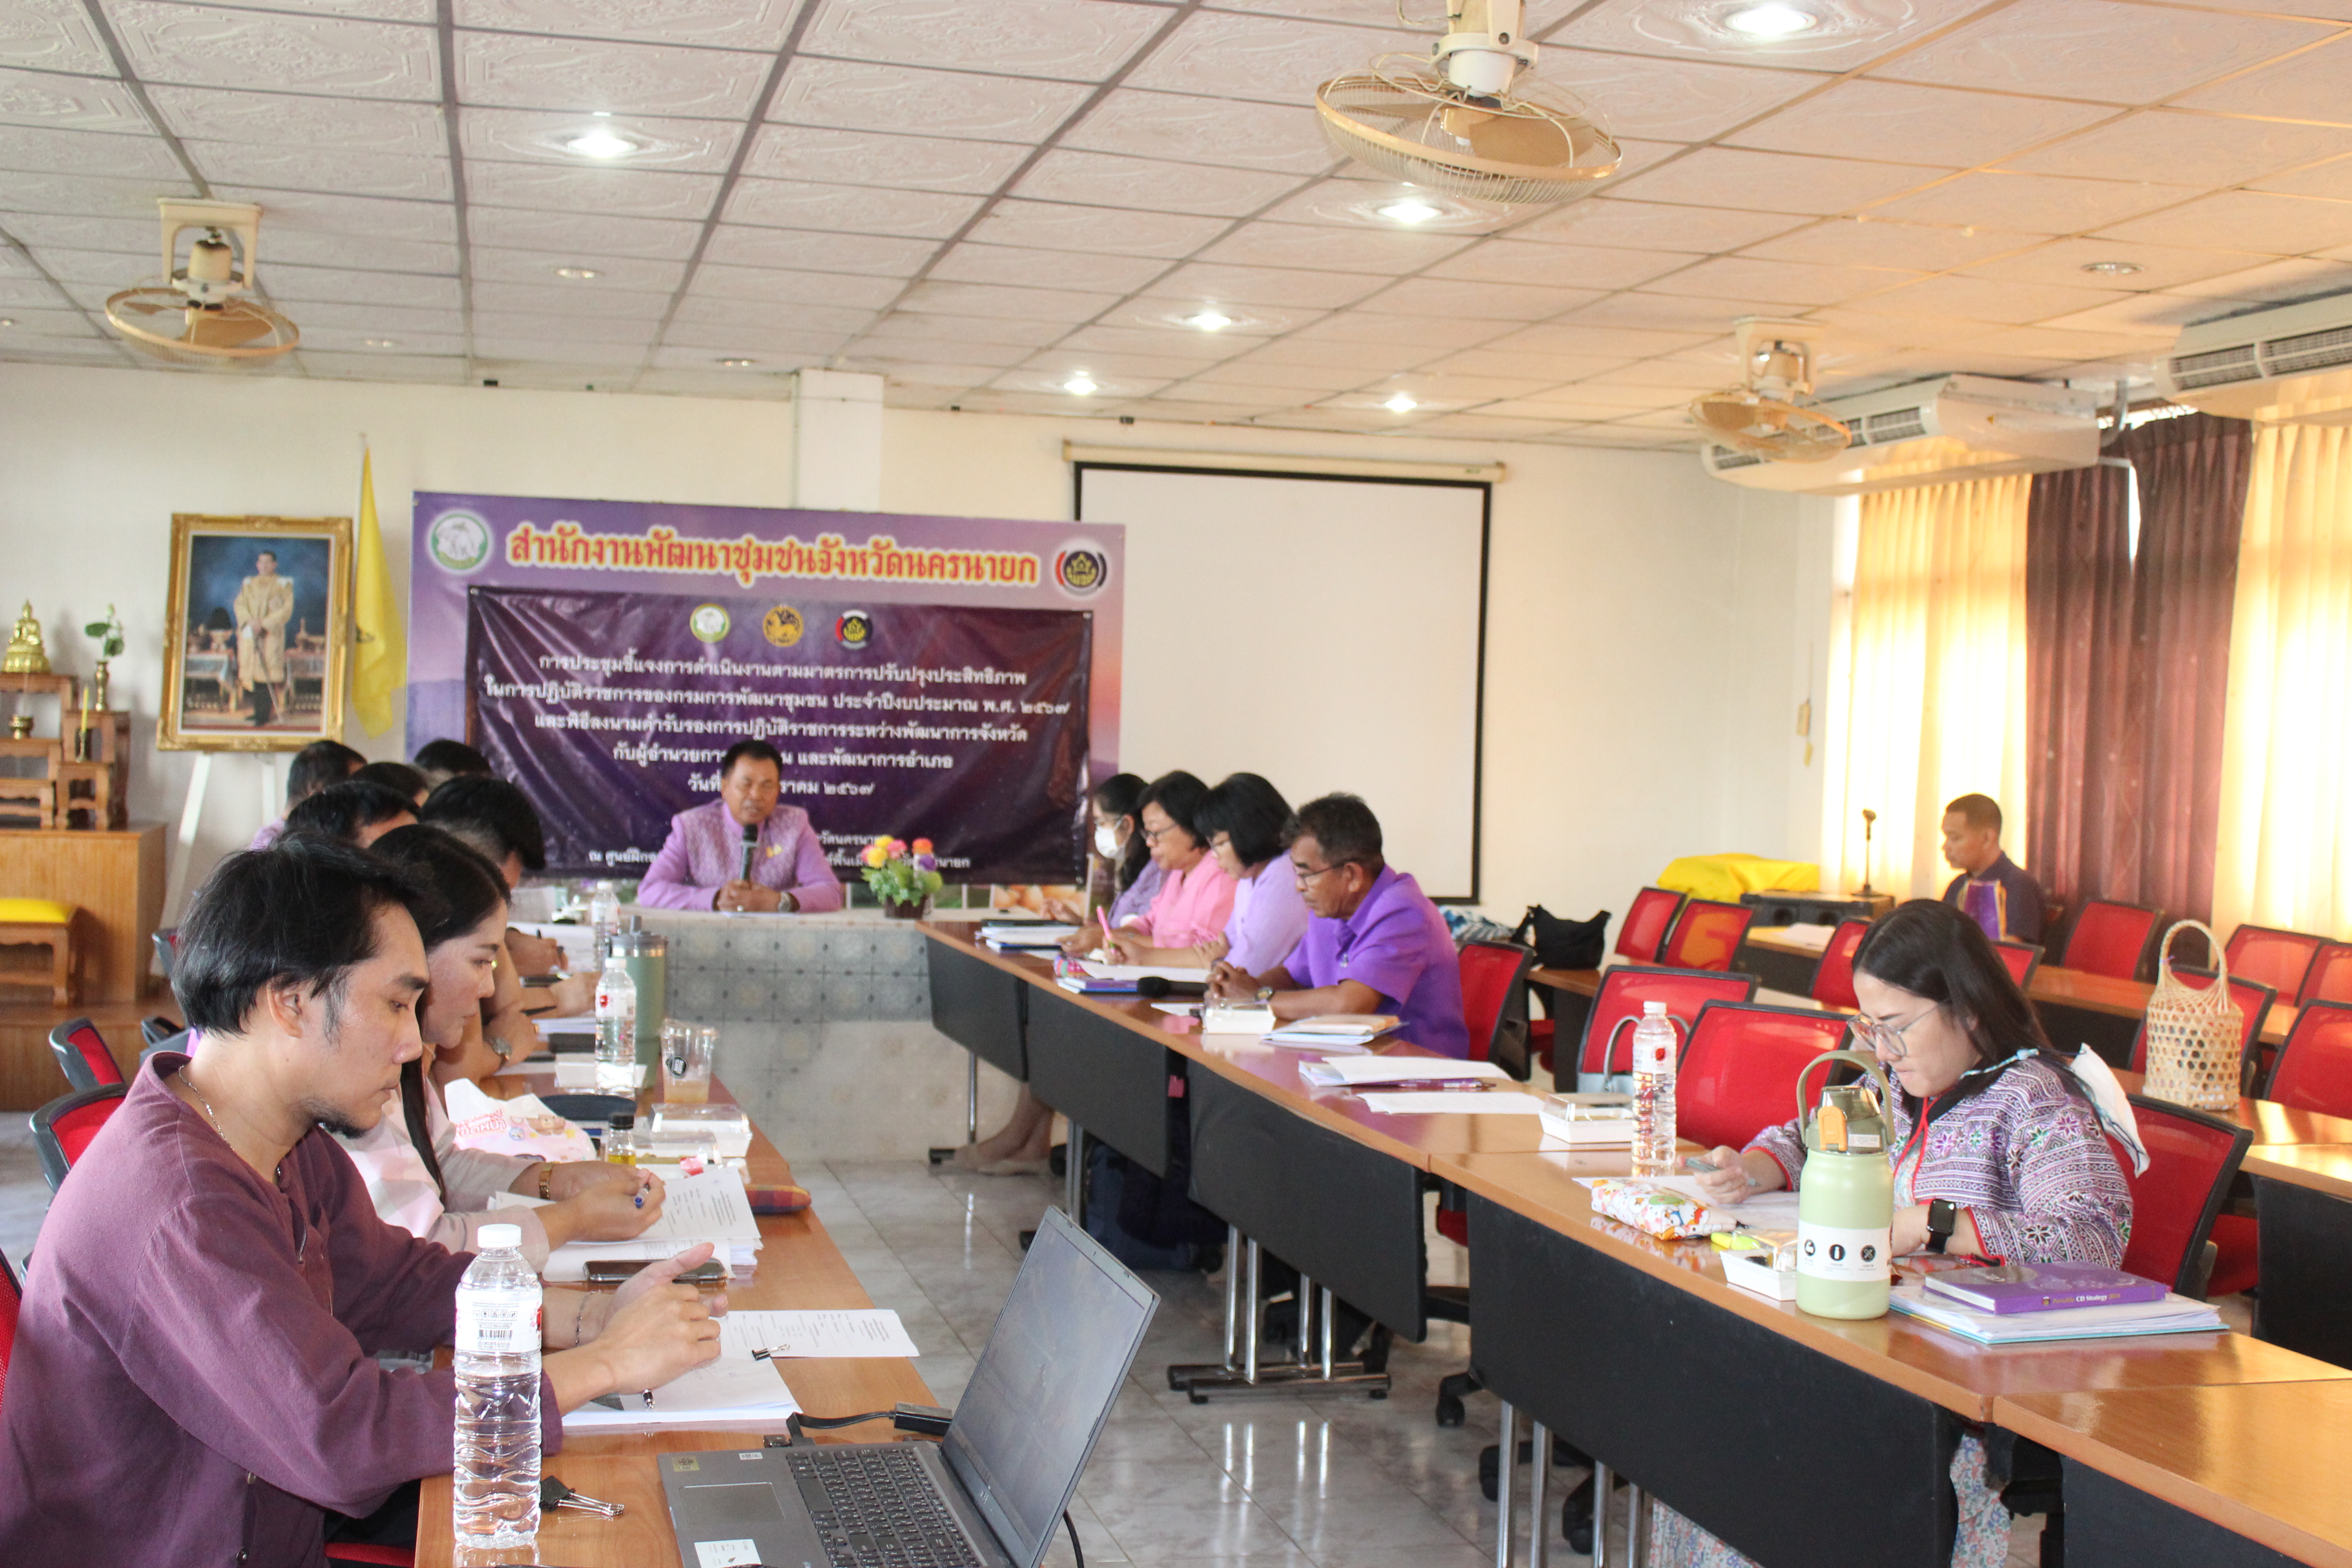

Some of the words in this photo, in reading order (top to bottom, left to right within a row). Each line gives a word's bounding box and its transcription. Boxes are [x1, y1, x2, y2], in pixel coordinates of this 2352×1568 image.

[507, 521, 1041, 586] สำนักงานพัฒนาชุมชนจังหวัดนครนายก
[539, 647, 1028, 689] การประชุมชี้แจงการดำเนินงานตามมาตรการปรับปรุงประสิทธิภาพ
[484, 673, 829, 712] ในการปฏิบัติราชการของกรมการพัฒนาชุมชน
[833, 690, 979, 712] ประจำปีงบประมาณ
[982, 699, 1017, 714] พ.ศ.
[1020, 700, 1071, 715] ๒๕๖๗
[534, 710, 1029, 742] และพิธีลงนามคำรับรองการปฏิบัติราชการระหว่างพัฒนาการจังหวัด
[797, 746, 954, 769] และพัฒนาการอำเภอ
[823, 780, 876, 795] ๒๕๖๗
